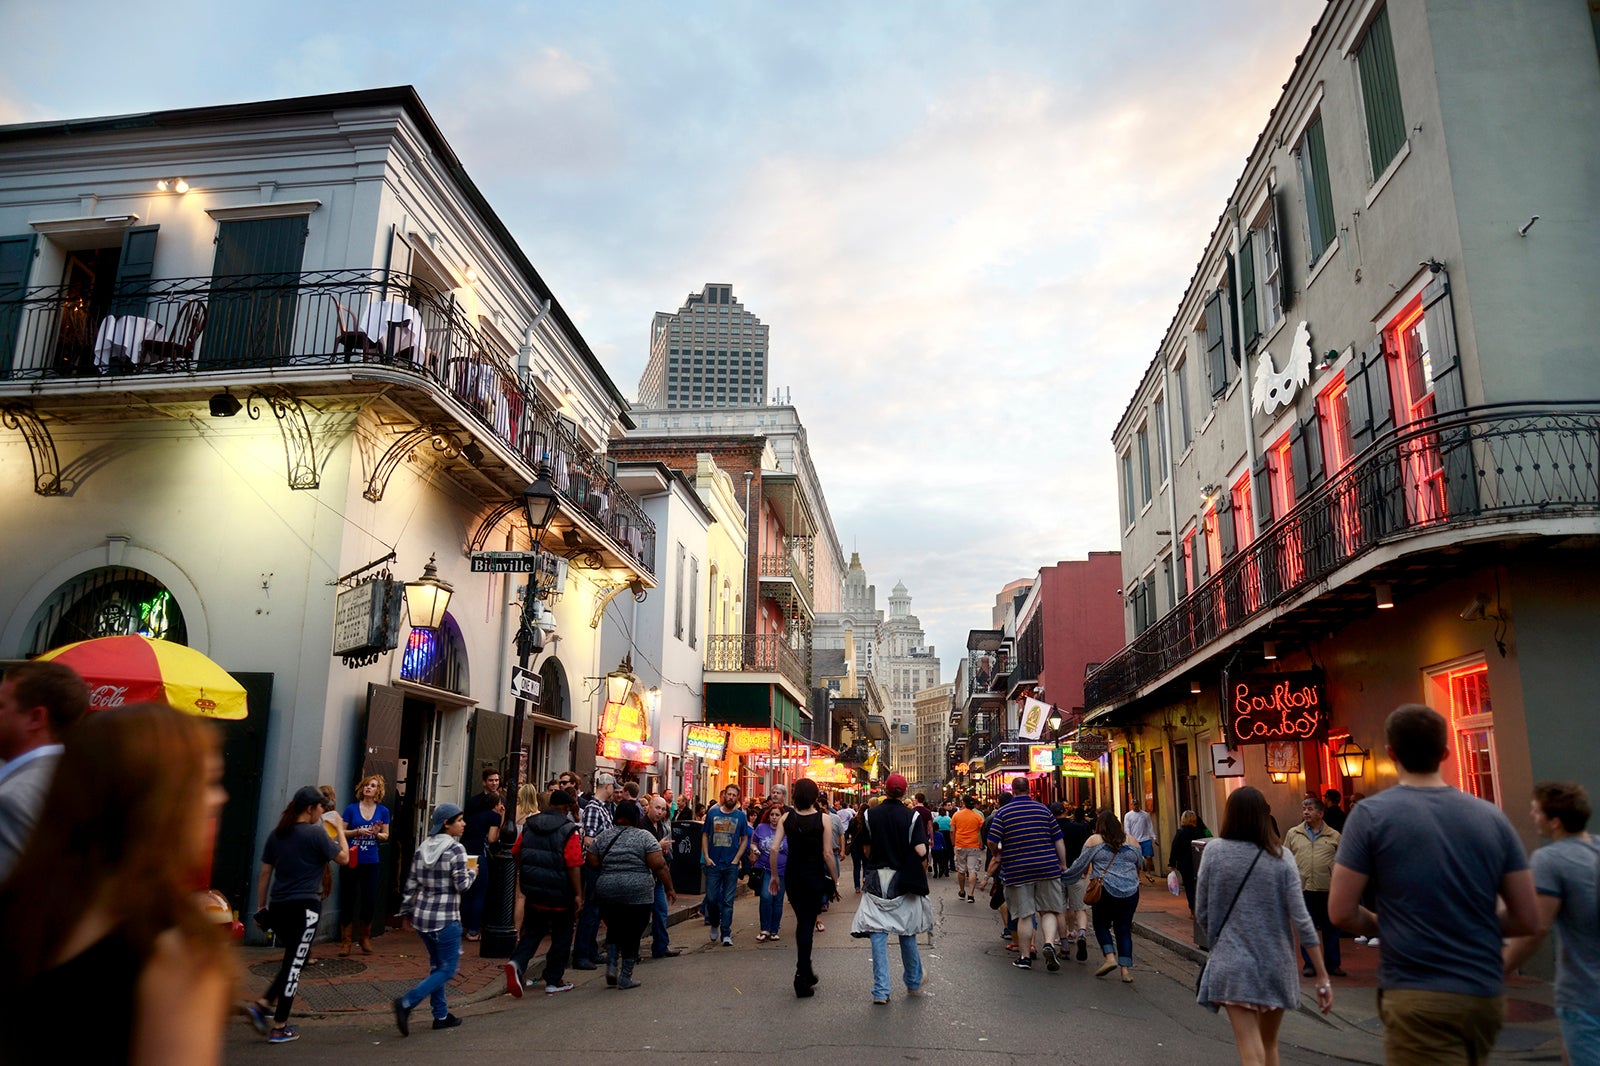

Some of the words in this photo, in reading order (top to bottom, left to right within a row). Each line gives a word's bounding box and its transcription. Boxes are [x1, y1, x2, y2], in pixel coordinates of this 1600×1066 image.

[474, 559, 532, 572] Bienville
[521, 678, 531, 692] ONE
[1274, 750, 1292, 760] NO
[1268, 760, 1299, 768] COVER
[284, 908, 320, 998] AGGIES
